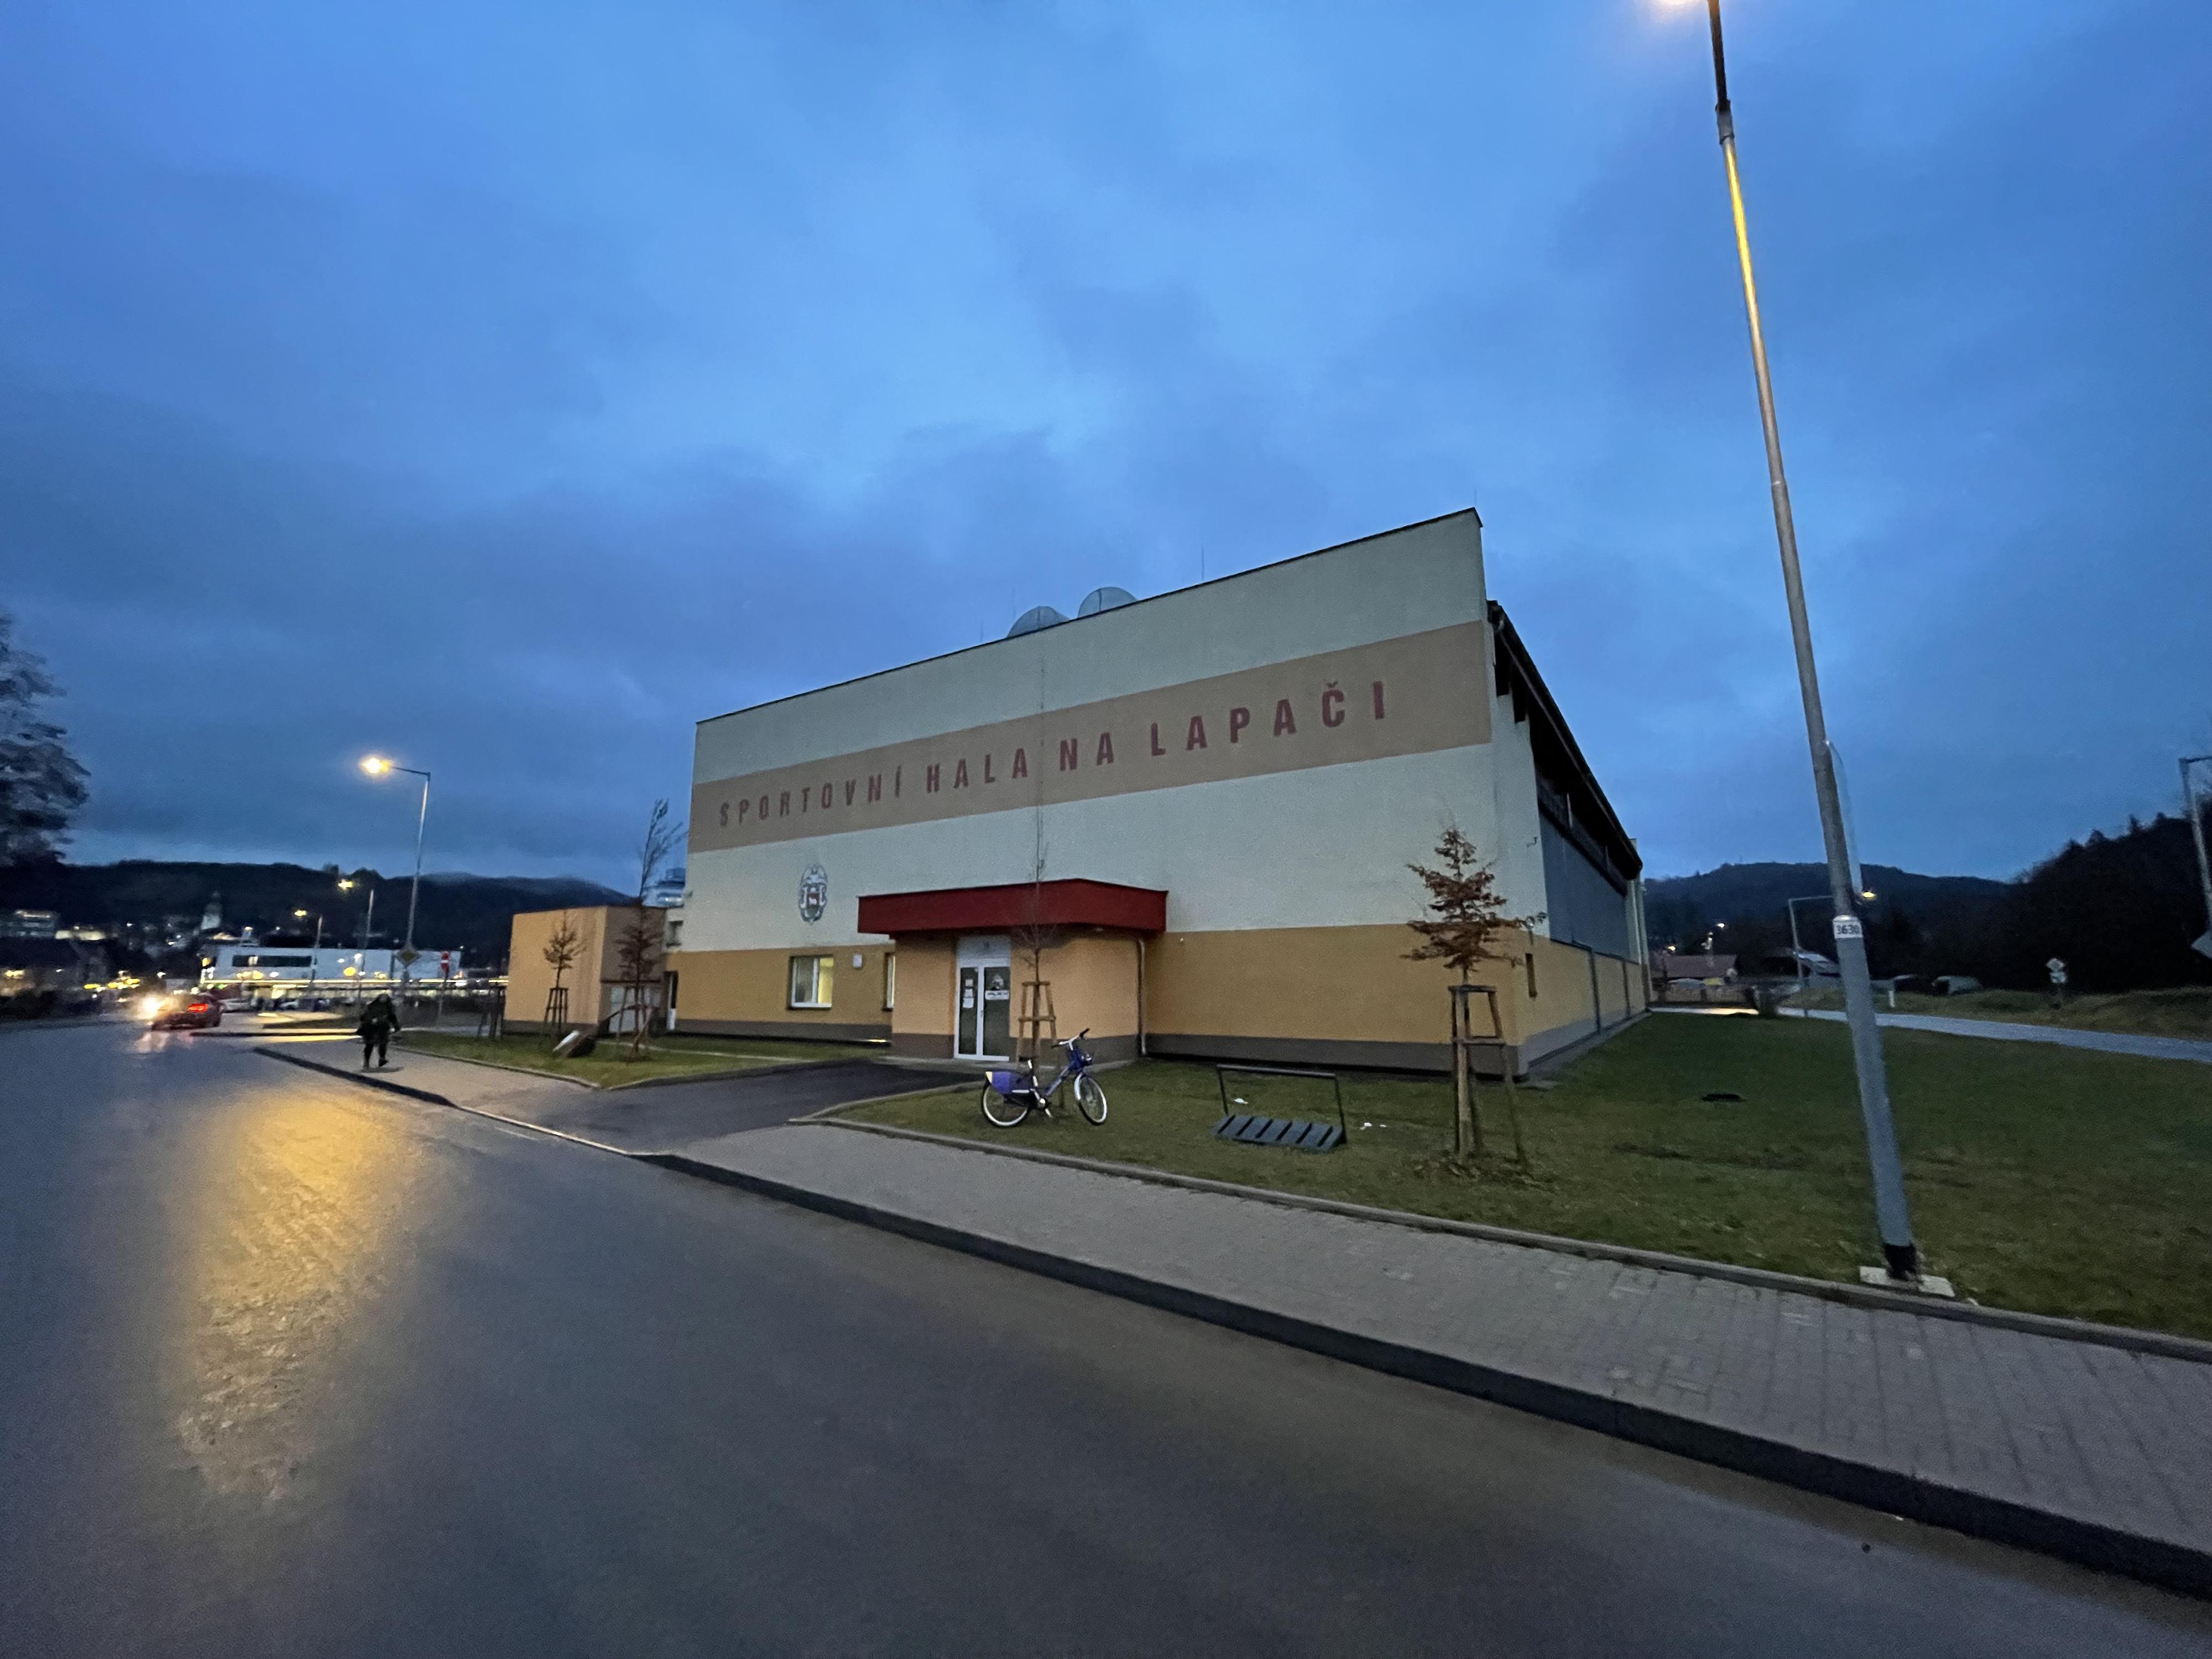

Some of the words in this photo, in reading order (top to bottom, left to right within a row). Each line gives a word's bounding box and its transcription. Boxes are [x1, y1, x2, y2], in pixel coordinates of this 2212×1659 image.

[719, 764, 901, 827] SPORTOVNÍ
[926, 748, 1029, 794] HALA
[1059, 732, 1115, 771] NA
[1150, 680, 1385, 757] LAPAČI
